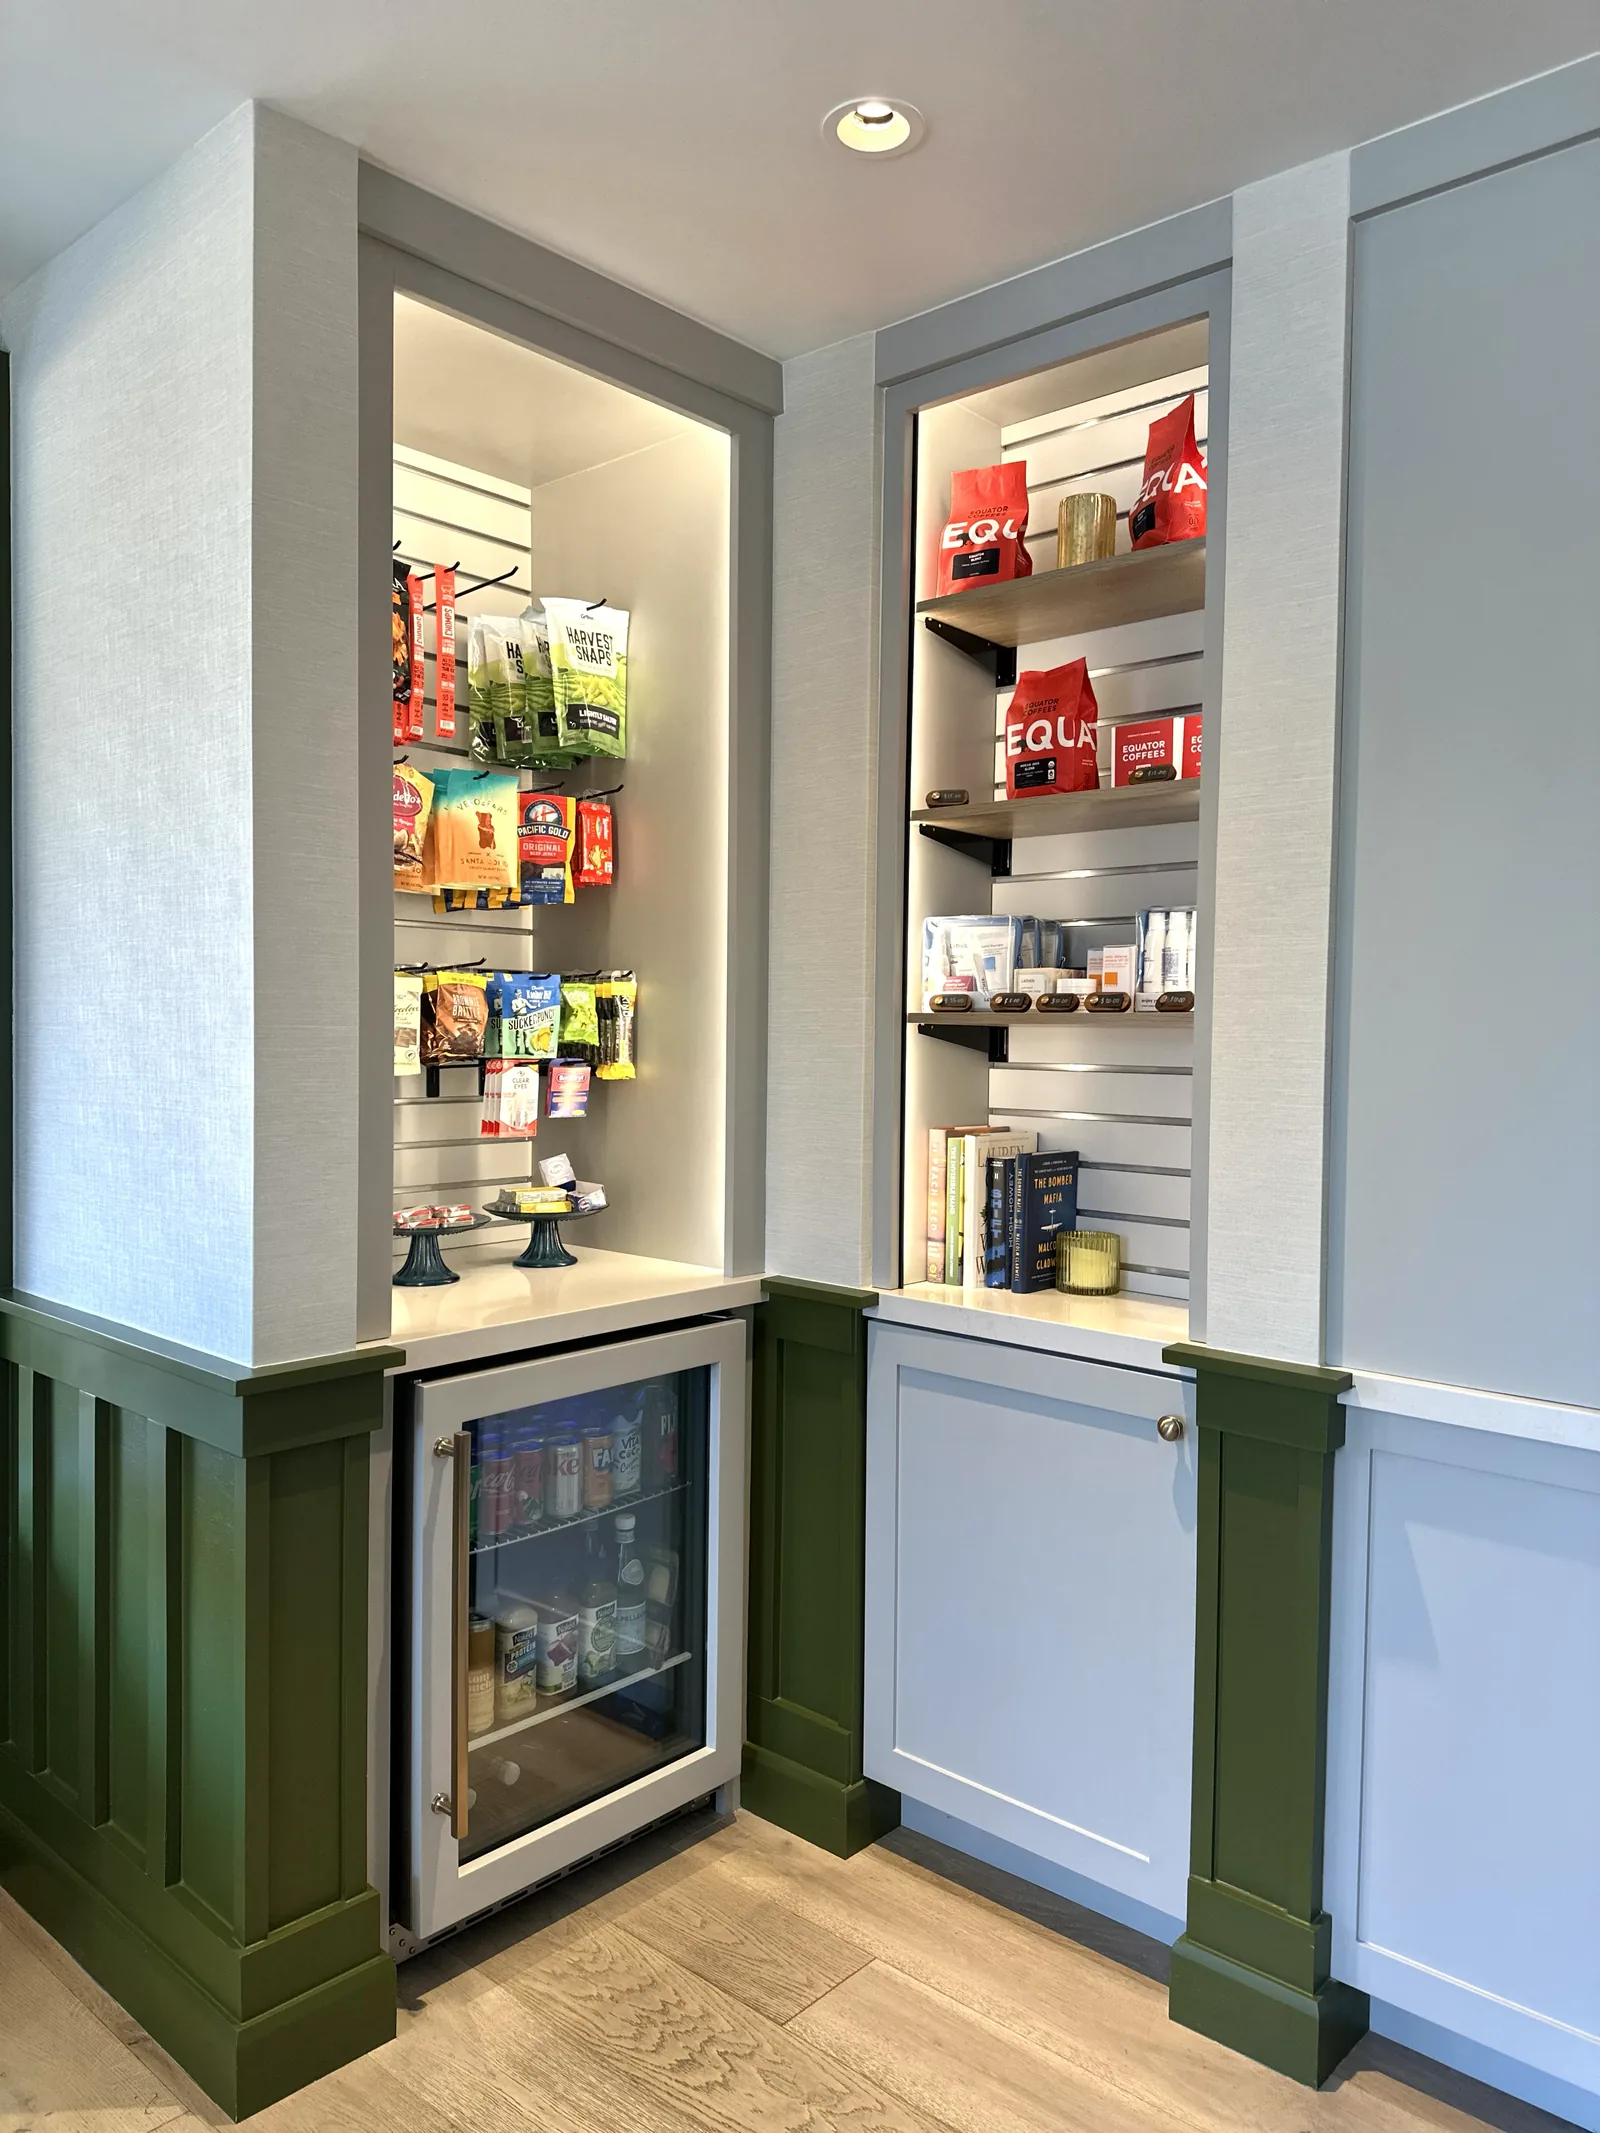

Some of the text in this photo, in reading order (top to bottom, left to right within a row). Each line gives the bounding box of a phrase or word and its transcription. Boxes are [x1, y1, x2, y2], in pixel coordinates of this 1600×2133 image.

[970, 505, 1008, 515] EQUATOR
[566, 626, 613, 653] HARVEST
[576, 645, 612, 667] SNAPS
[1025, 698, 1060, 709] EQUATOR
[1022, 705, 1057, 717] COFFEES
[1122, 740, 1166, 754] EQUATOR
[1122, 749, 1166, 762] COFFEES
[517, 825, 569, 839] PACIFIC GOLD
[522, 842, 563, 853] ORIGINAL
[460, 858, 484, 866] SANTA
[1034, 1174, 1073, 1189] THE BOMBER
[1043, 1192, 1063, 1205] MAFIA
[1038, 1242, 1056, 1253] MALCO
[511, 1642, 536, 1660] PROTEIN
